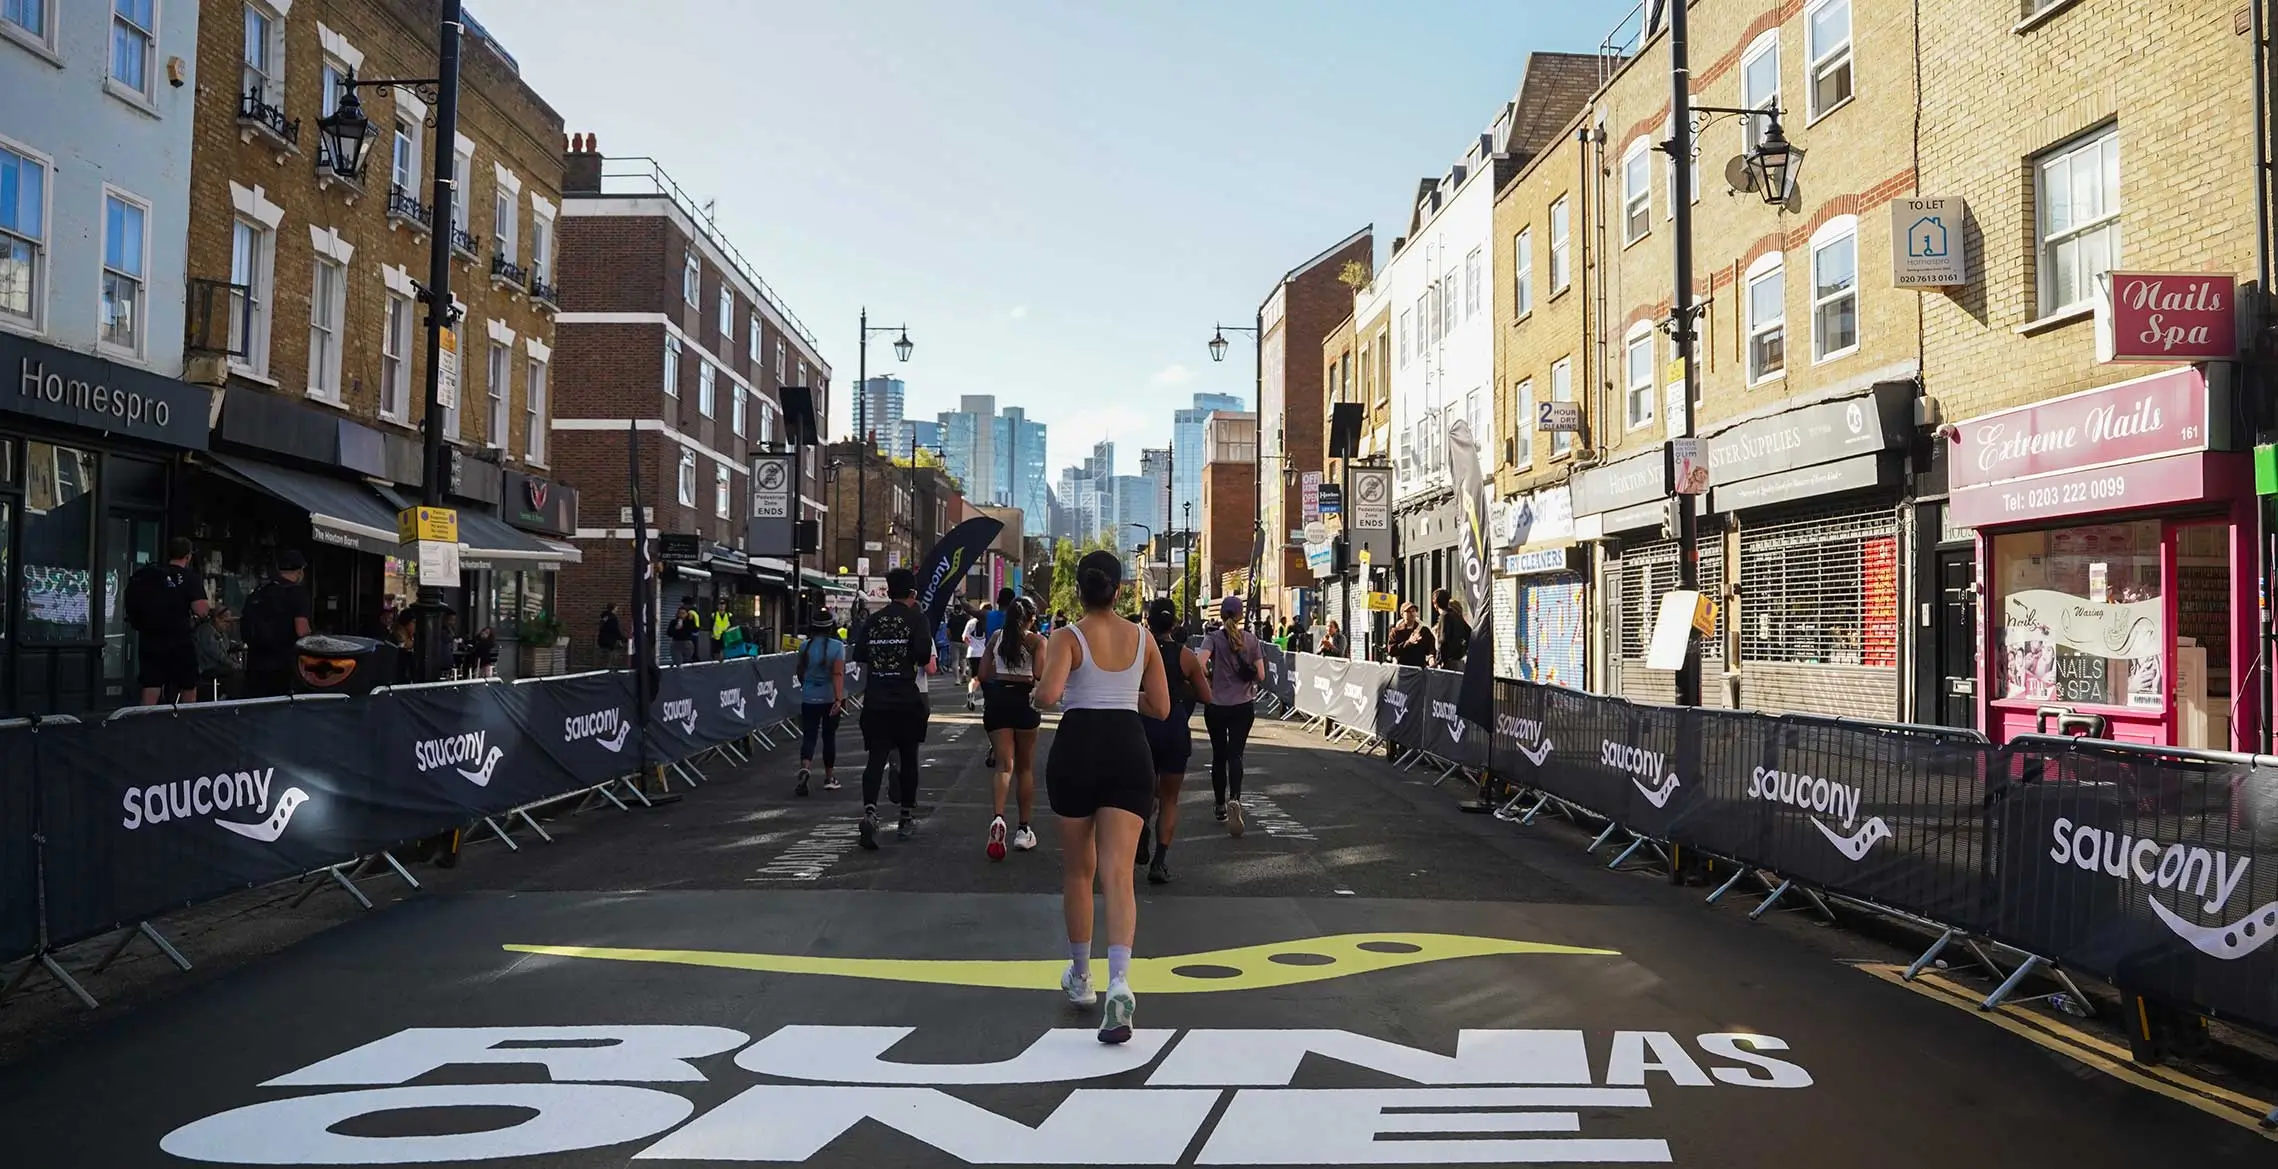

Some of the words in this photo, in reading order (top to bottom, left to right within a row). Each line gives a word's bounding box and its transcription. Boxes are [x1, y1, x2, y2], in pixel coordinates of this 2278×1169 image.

[1908, 201, 1923, 210] TO
[1926, 200, 1945, 209] LET
[1900, 275, 1915, 283] 020
[1917, 275, 1936, 283] 7613
[1938, 274, 1958, 282] 0161
[1907, 258, 1950, 267] Homespro
[2122, 280, 2224, 311] Nails
[2140, 313, 2212, 351] Spa
[21, 356, 170, 427] Homespro
[1540, 402, 1553, 423] 2
[1977, 423, 2077, 472] Extreme
[2084, 396, 2163, 445] Nails
[2181, 426, 2198, 440] 161
[1675, 451, 1697, 464] gum
[1709, 445, 1742, 468] STER
[2003, 493, 2025, 511] Tel:
[2029, 487, 2058, 508] 0203
[2064, 482, 2086, 503] 222
[2091, 475, 2125, 499] 0099
[758, 507, 783, 515] ENDS
[1360, 519, 1384, 527] ENDS
[314, 527, 325, 540] The
[1944, 524, 1977, 540] HOUS
[1521, 550, 1563, 572] CLEANERS
[919, 555, 952, 614] aucony
[2056, 659, 2102, 681] NAILS
[2067, 682, 2102, 700] SPA
[564, 707, 620, 742] saucony
[663, 698, 693, 722] saucony
[1496, 713, 1543, 748] saucony
[416, 730, 485, 772] saucony
[1601, 738, 1665, 785] saucony
[123, 767, 274, 830] saucony
[1747, 765, 1861, 829] saucony
[743, 838, 859, 881] LOADING
[2048, 816, 2251, 914] saucony
[256, 1024, 1592, 1086] RUN
[1606, 1030, 1815, 1088] AS
[159, 1083, 1674, 1165] ONE
